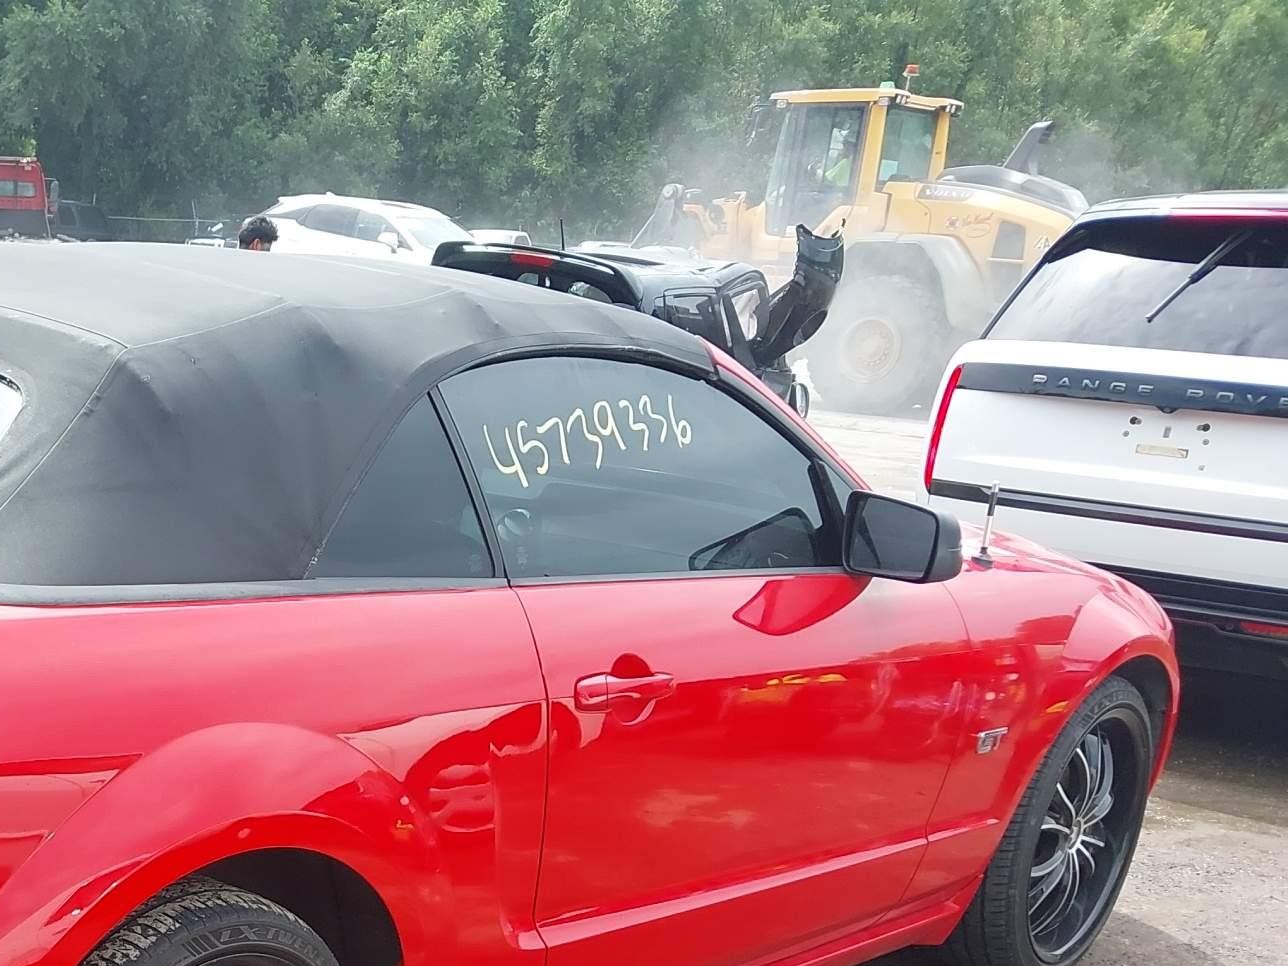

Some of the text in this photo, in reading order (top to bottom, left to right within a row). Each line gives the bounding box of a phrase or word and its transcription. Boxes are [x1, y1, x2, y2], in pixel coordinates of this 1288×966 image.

[1032, 373, 1155, 394] RANGE
[482, 394, 692, 488] 45739336
[975, 726, 1009, 754] GT
